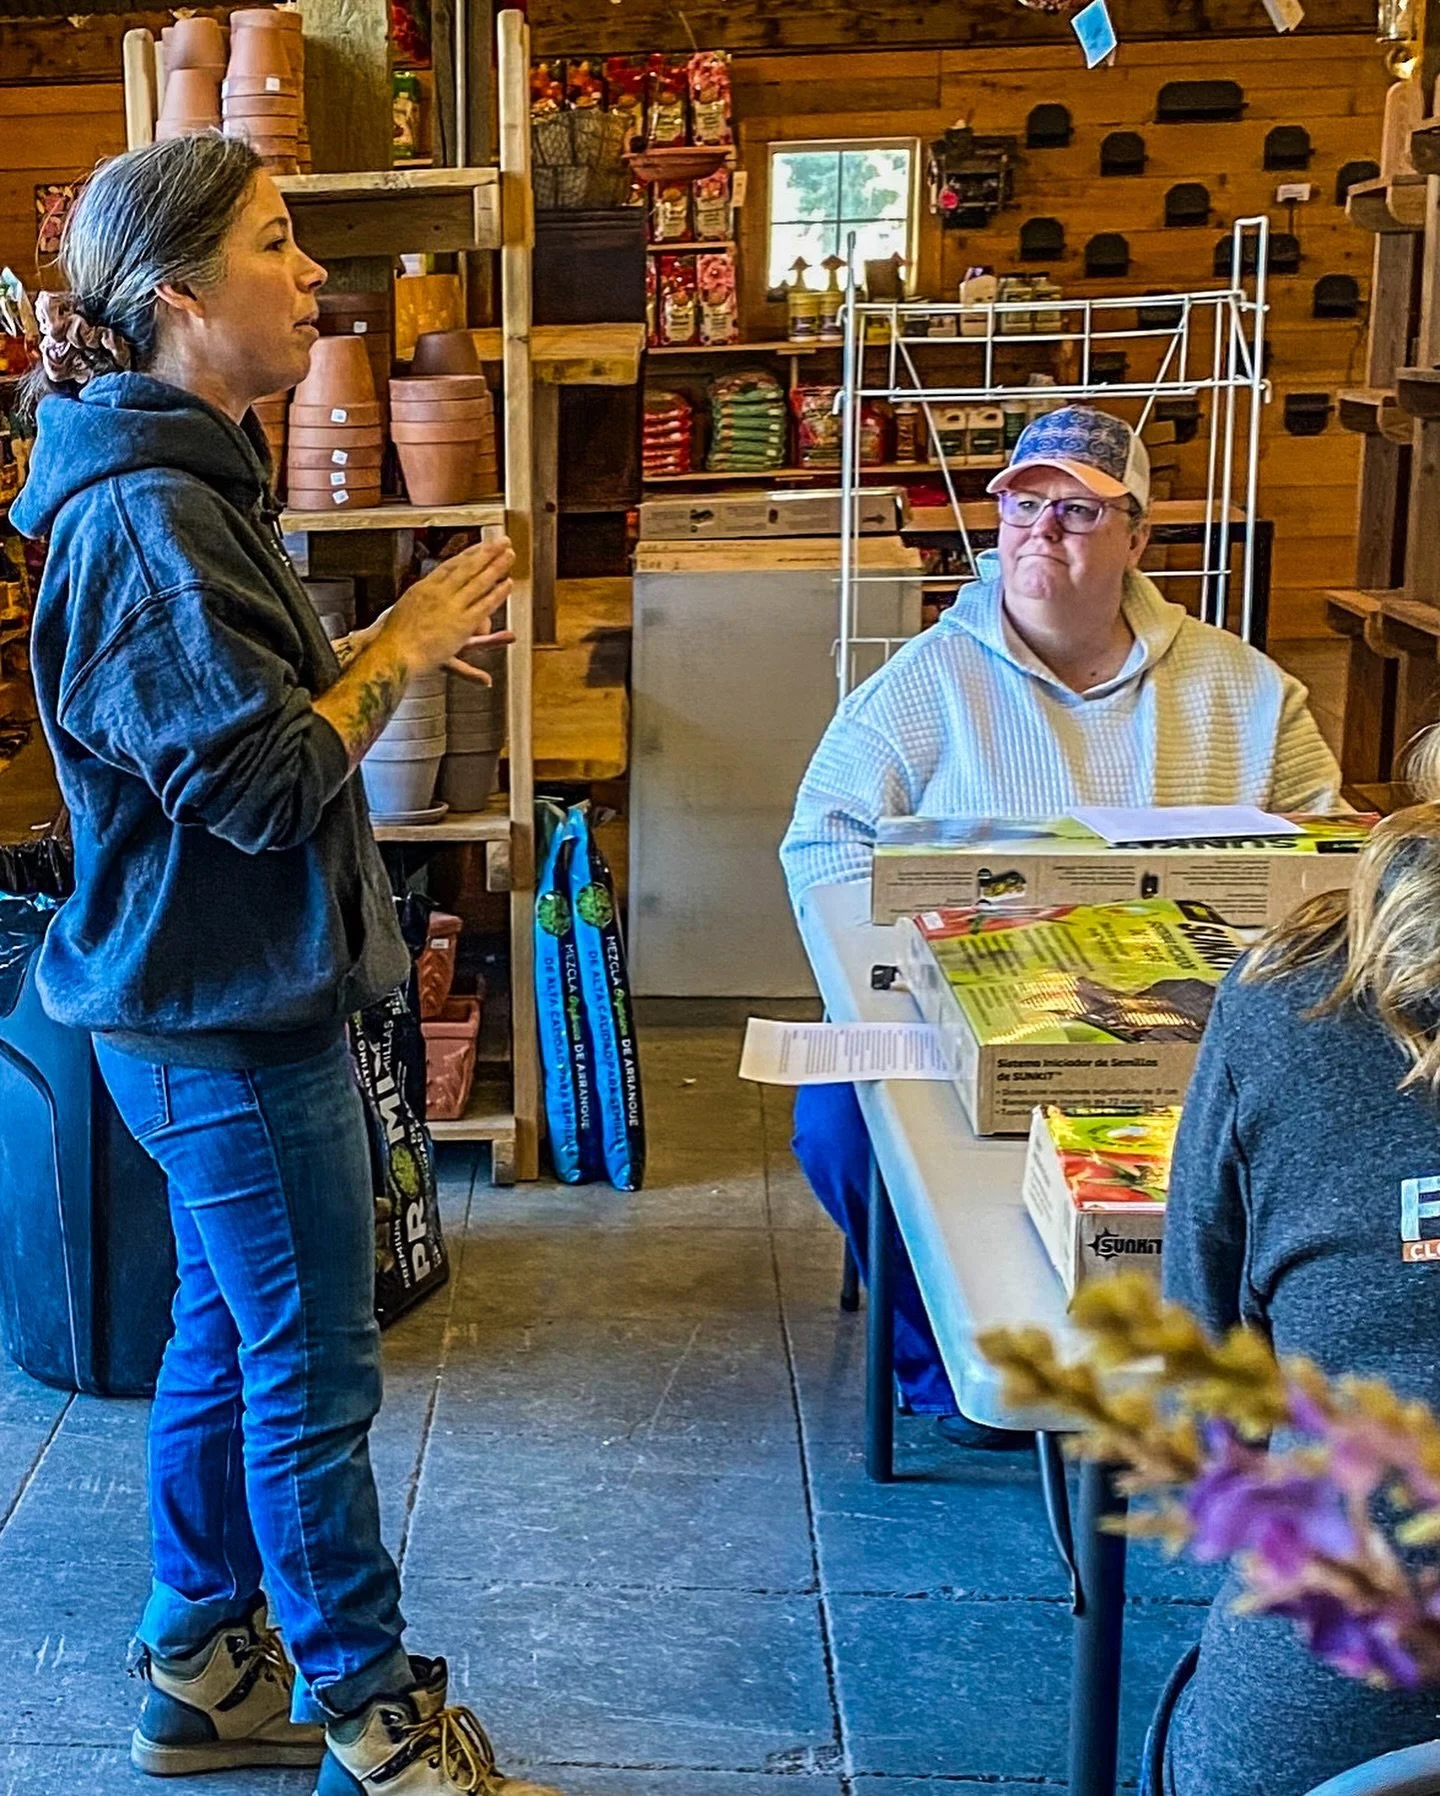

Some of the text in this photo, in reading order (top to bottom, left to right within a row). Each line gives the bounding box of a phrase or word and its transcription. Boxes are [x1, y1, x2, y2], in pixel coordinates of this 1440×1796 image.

[544, 957, 556, 972] DE
[565, 944, 578, 993] MEZCLA
[588, 951, 599, 966] DE
[605, 936, 622, 986] MEZCLA
[547, 978, 560, 1007] ALTA
[592, 971, 606, 1001] ALTA
[598, 1005, 614, 1058] CALIDAD
[574, 1044, 585, 1060] DE
[621, 1039, 633, 1056] DE
[997, 1073, 1010, 1081] de
[1095, 1059, 1108, 1067] de
[1111, 1058, 1158, 1067] Semillas
[576, 1063, 590, 1130] ARRANQUE
[624, 1059, 639, 1127] ARRANQUE
[394, 1218, 411, 1289] PREMIUM
